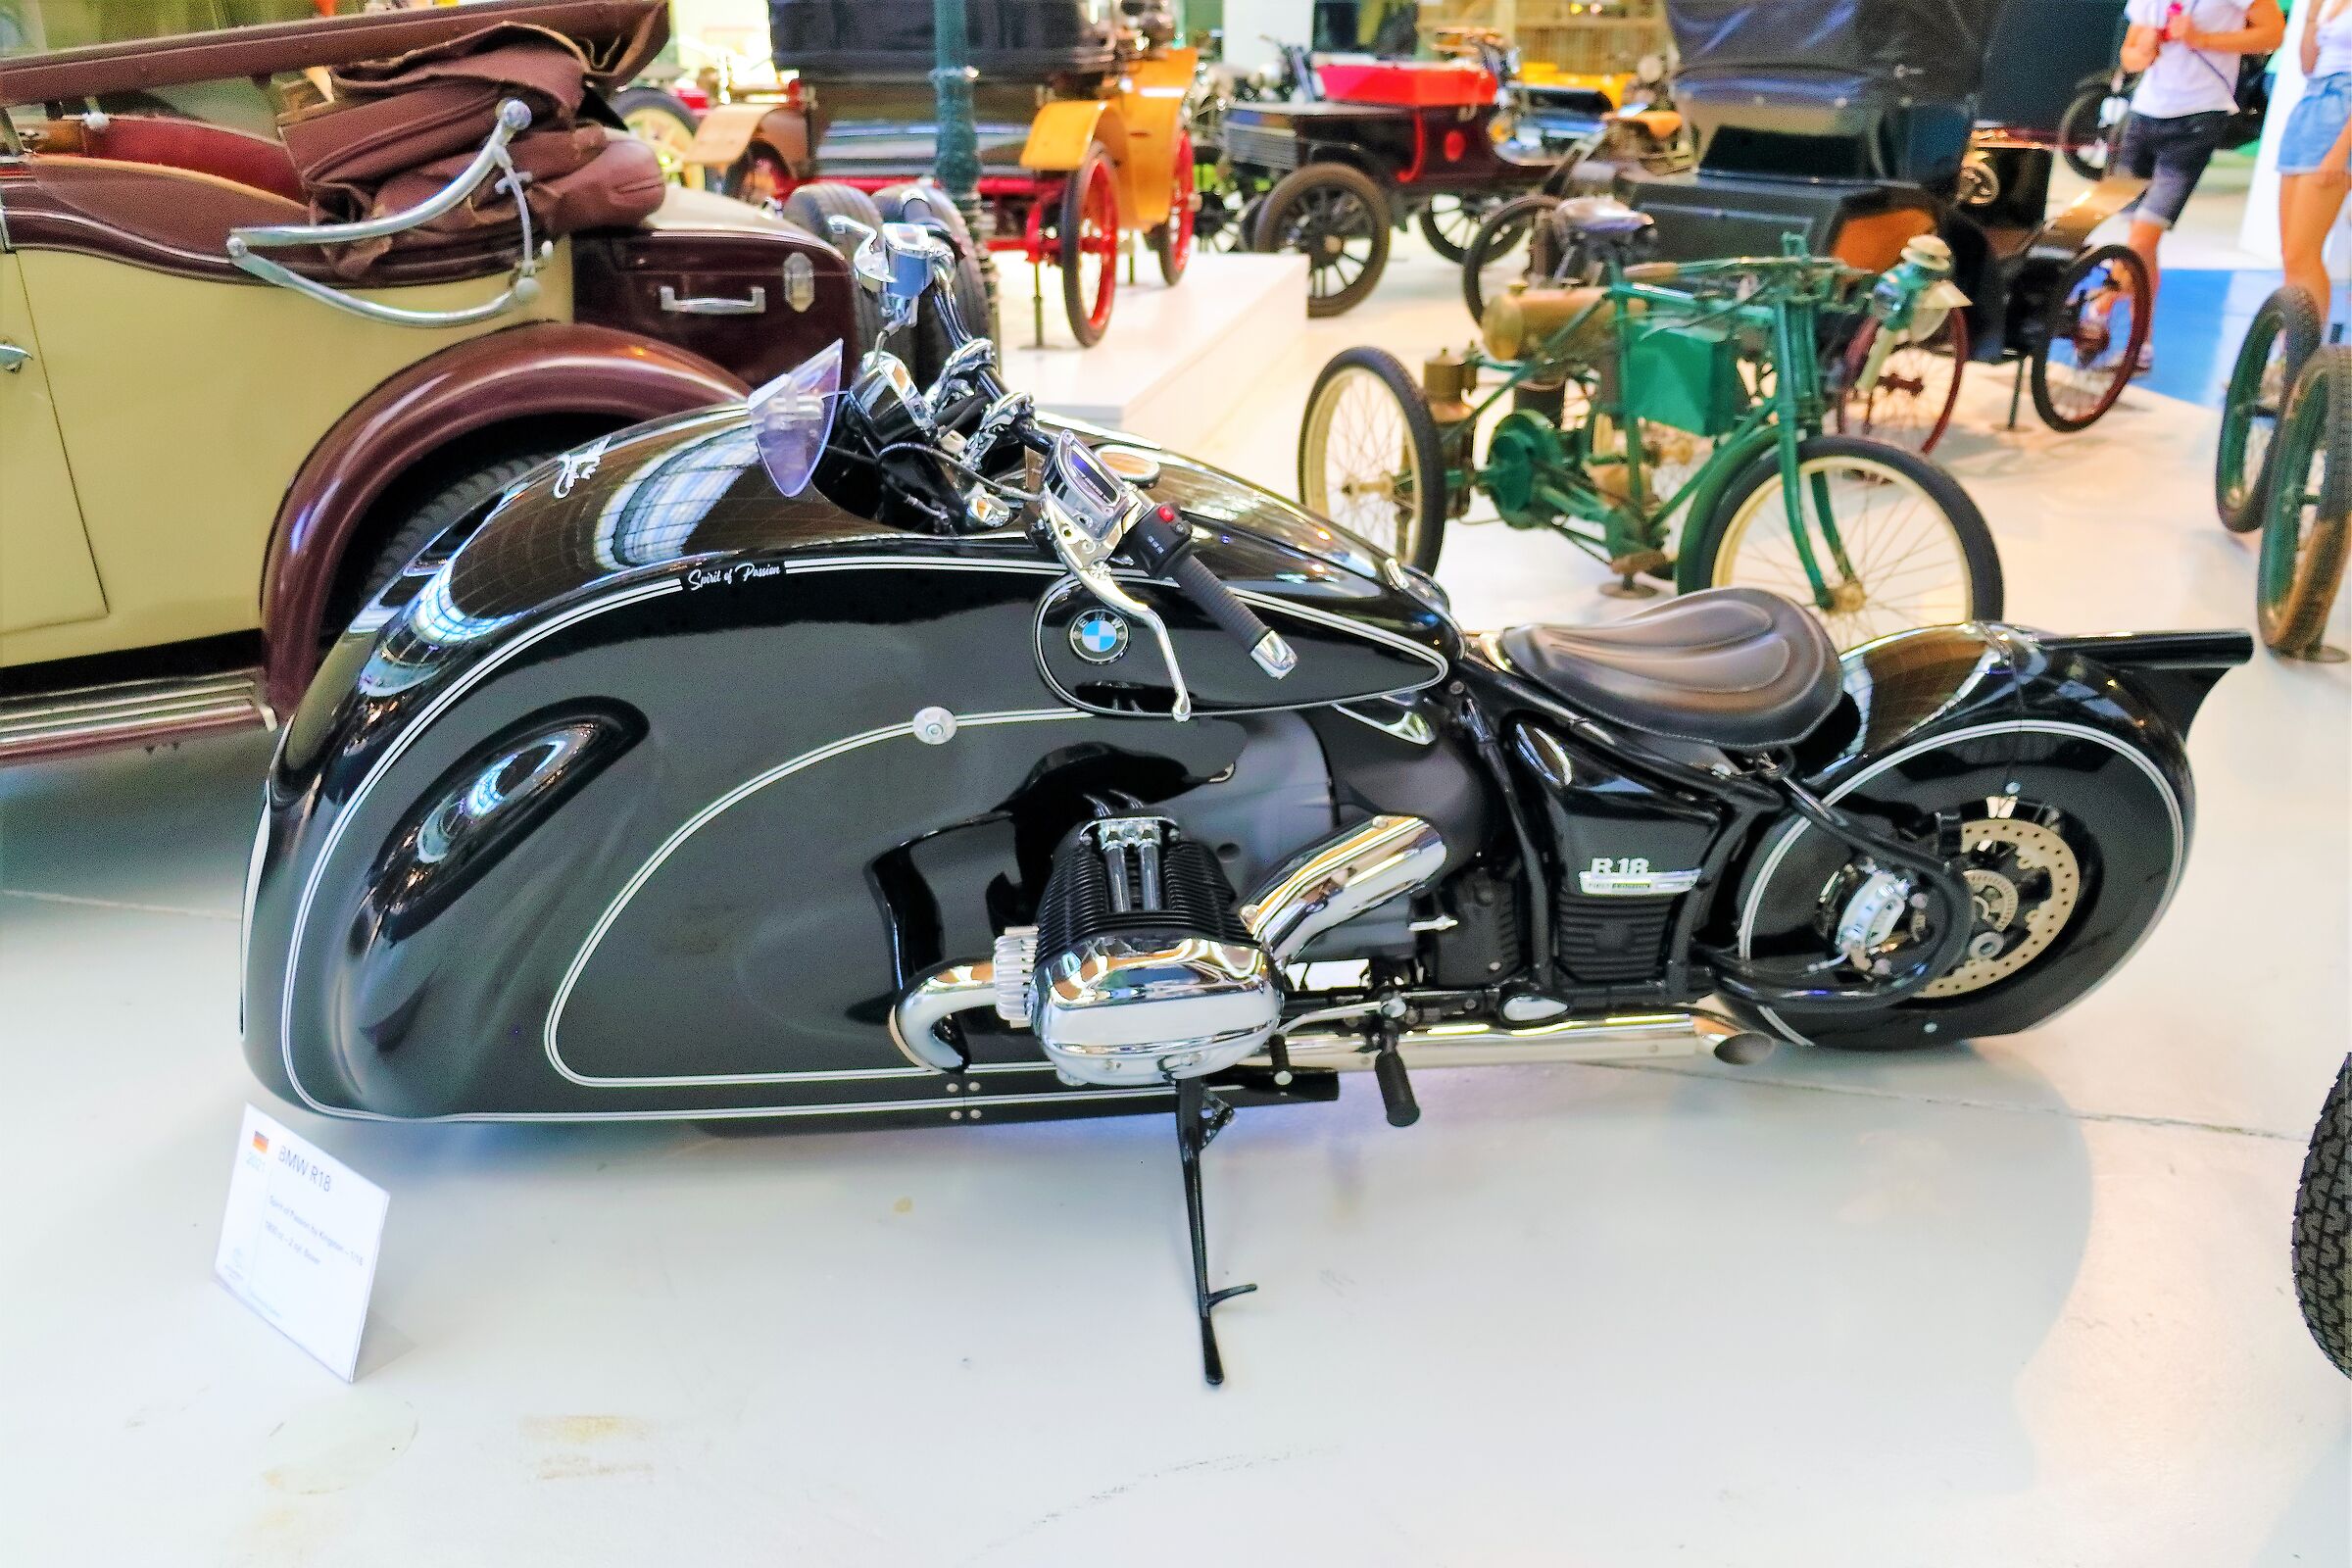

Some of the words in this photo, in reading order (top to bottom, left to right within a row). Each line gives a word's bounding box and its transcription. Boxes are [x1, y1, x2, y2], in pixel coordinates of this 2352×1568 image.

[688, 568, 722, 591] Spirit
[723, 568, 733, 585] of
[734, 563, 780, 582] Passion
[1077, 611, 1124, 628] BMW
[277, 1145, 310, 1177] BMW
[310, 1165, 331, 1193] R18
